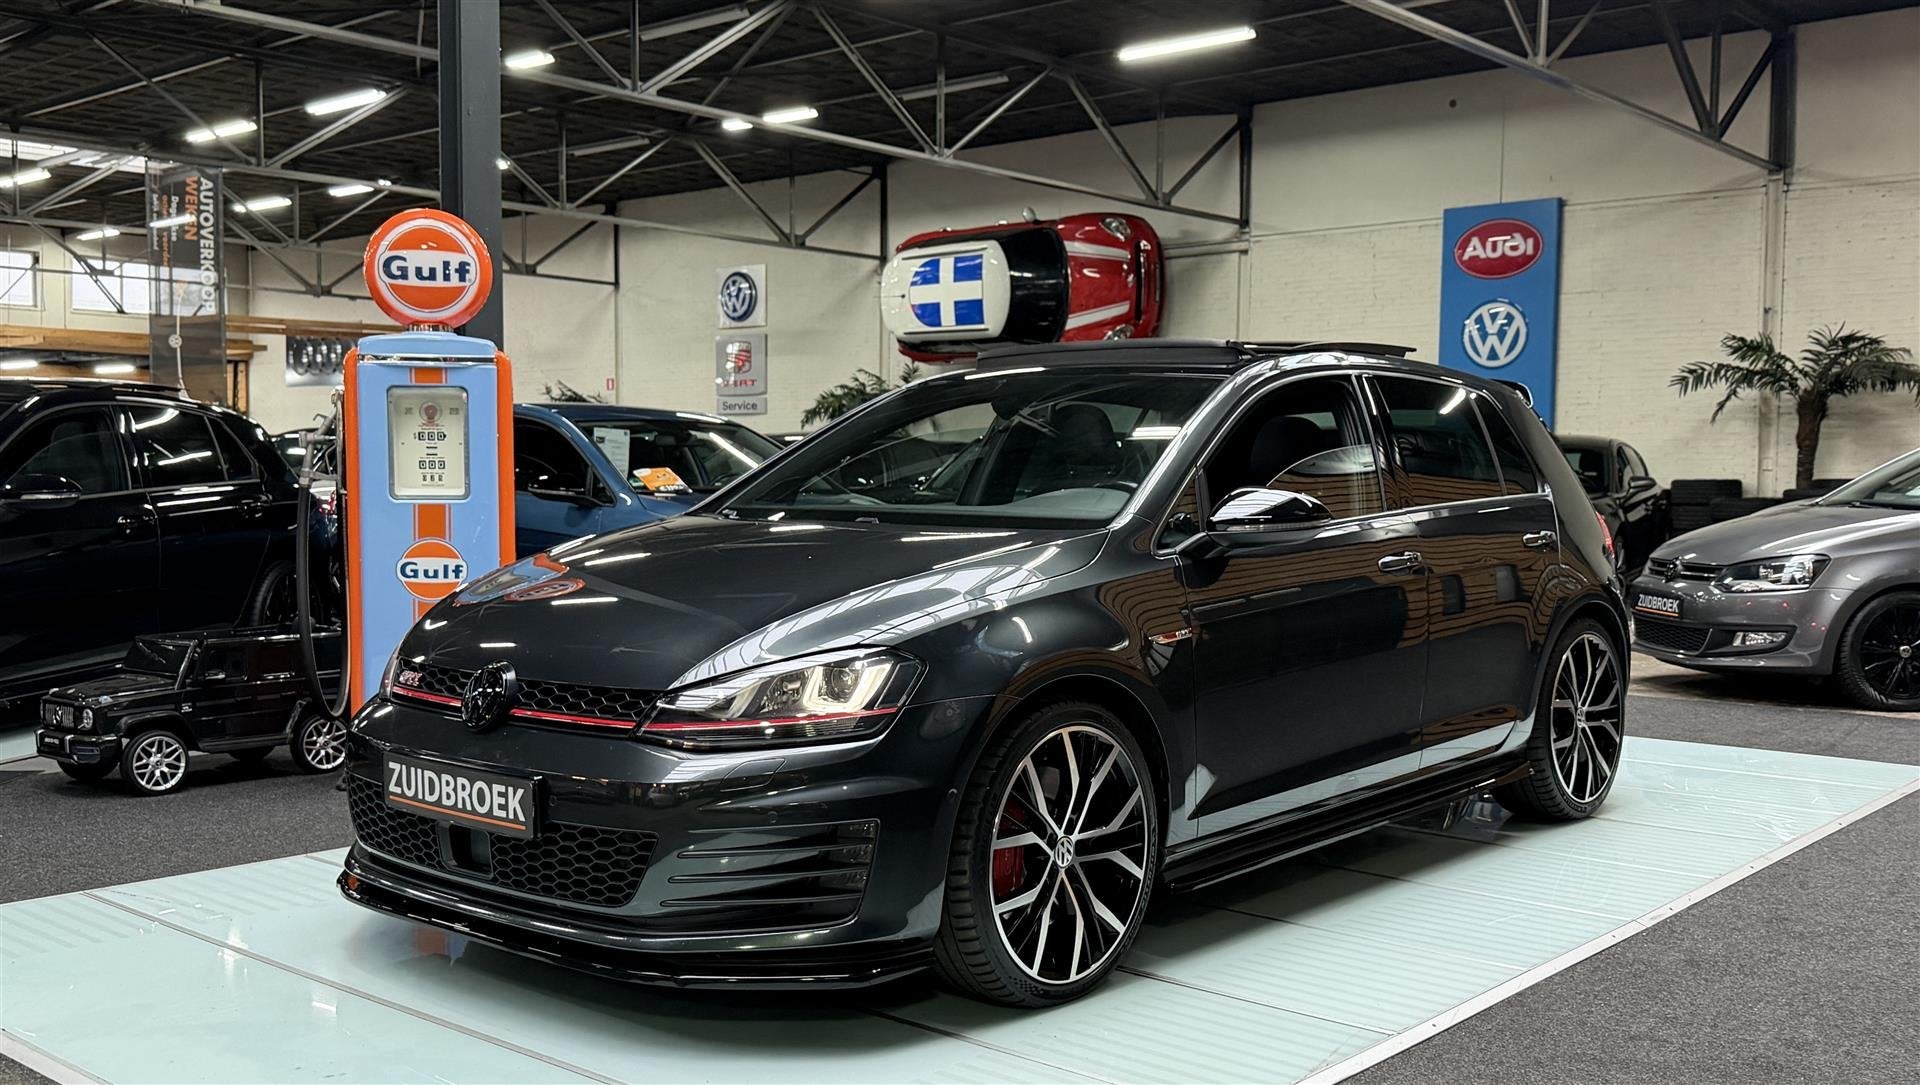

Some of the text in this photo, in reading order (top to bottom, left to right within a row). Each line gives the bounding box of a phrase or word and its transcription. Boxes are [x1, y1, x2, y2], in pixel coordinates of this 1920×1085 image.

[200, 176, 216, 313] AUTOVERKOOP
[382, 255, 471, 283] Gulf
[722, 402, 757, 411] Service
[400, 561, 464, 579] Gulf
[1637, 594, 1679, 613] ZUIDBROEK
[388, 761, 526, 822] ZUIDBROEK
